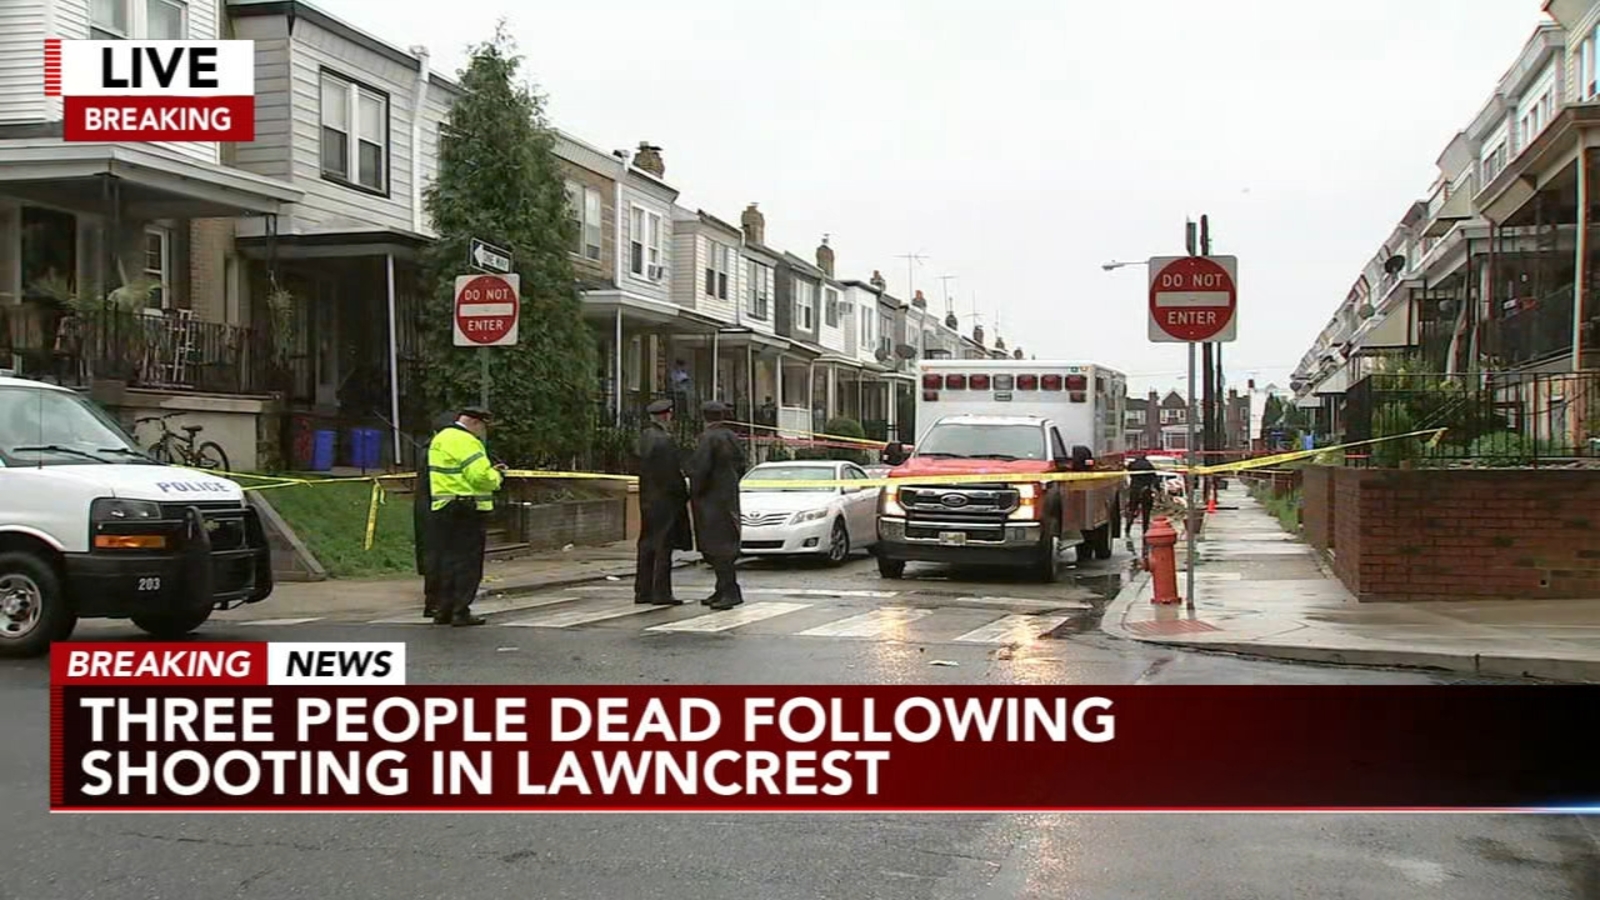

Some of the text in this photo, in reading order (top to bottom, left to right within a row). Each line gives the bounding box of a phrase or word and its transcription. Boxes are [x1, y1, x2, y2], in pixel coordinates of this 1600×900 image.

[1162, 272, 1223, 288] DO NOT
[464, 289, 509, 301] DO NOT
[1167, 310, 1217, 326] ENTER
[467, 320, 504, 332] ENTER
[155, 481, 231, 493] POLICE
[138, 577, 161, 591] 203
